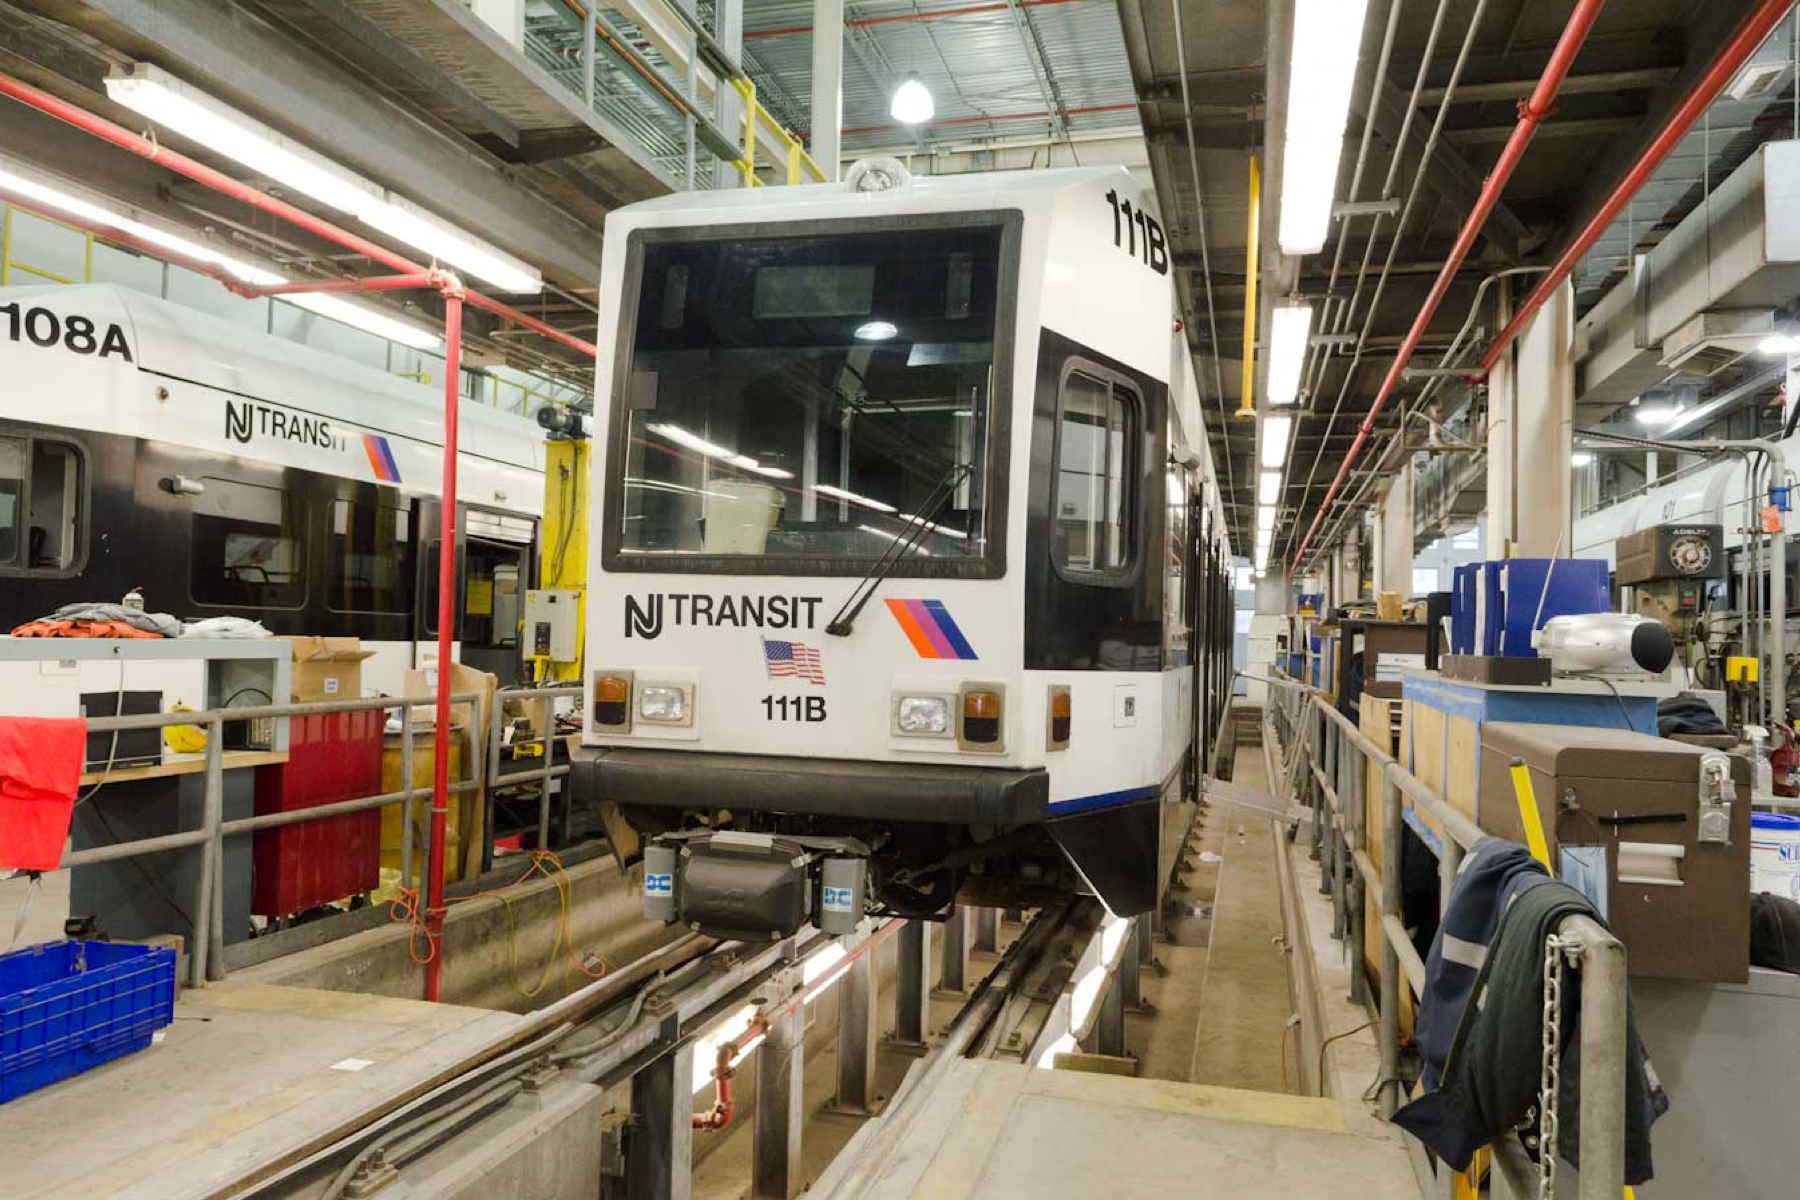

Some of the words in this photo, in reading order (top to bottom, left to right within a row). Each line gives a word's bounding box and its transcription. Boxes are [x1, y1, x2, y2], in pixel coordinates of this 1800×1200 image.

[1105, 188, 1168, 276] 111B
[0, 302, 133, 363] 108A
[624, 593, 664, 640] NJ
[668, 593, 823, 629] TRANSIT
[761, 694, 827, 722] 111B
